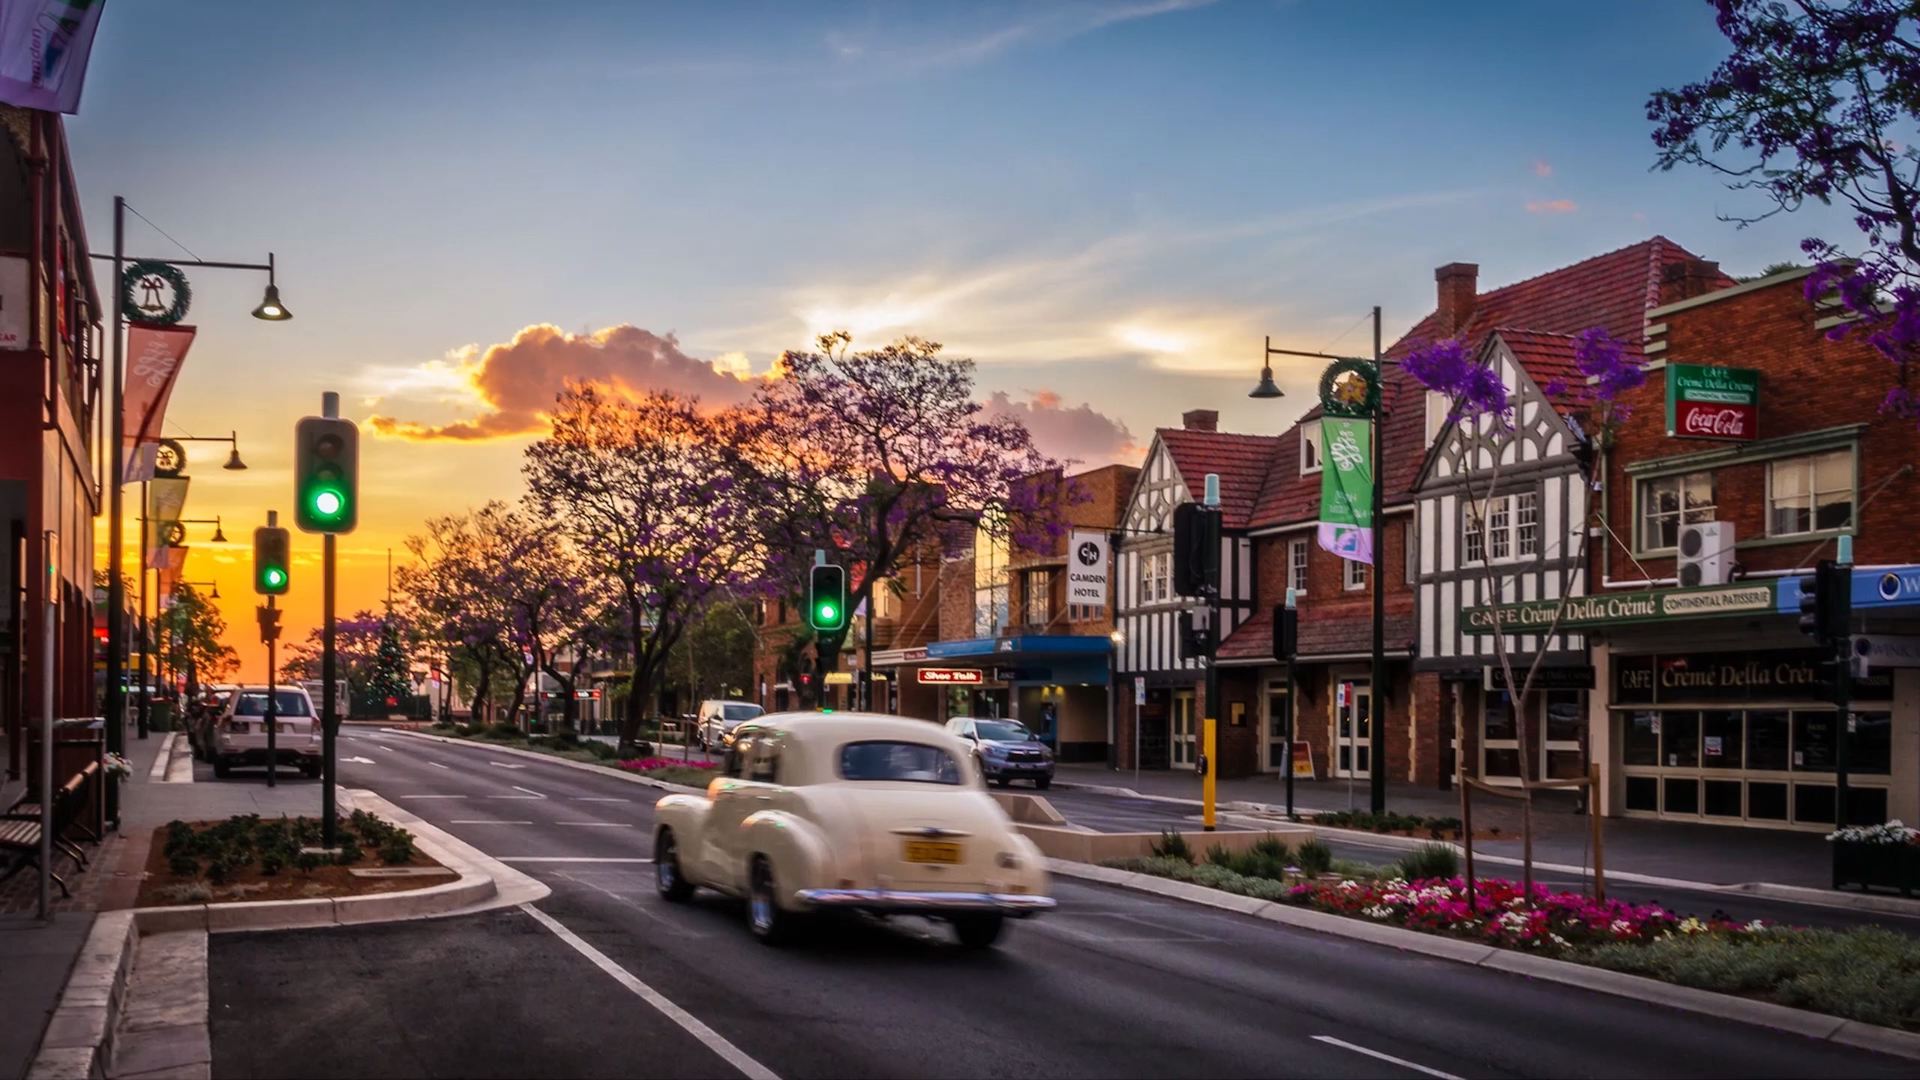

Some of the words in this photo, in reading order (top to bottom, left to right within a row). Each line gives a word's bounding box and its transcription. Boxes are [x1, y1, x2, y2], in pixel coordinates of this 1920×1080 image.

[1070, 572, 1106, 584] CAMDEN
[1074, 587, 1100, 598] HOTEL
[1470, 609, 1518, 626] CAFE
[1566, 599, 1606, 620] Della
[1665, 596, 1720, 610] CONTINENTAL
[1722, 591, 1769, 605] PATISSERIE
[924, 671, 951, 680] Shoe
[953, 671, 977, 681] Talk
[1622, 670, 1652, 688] CAFE
[1720, 663, 1770, 687] Della
